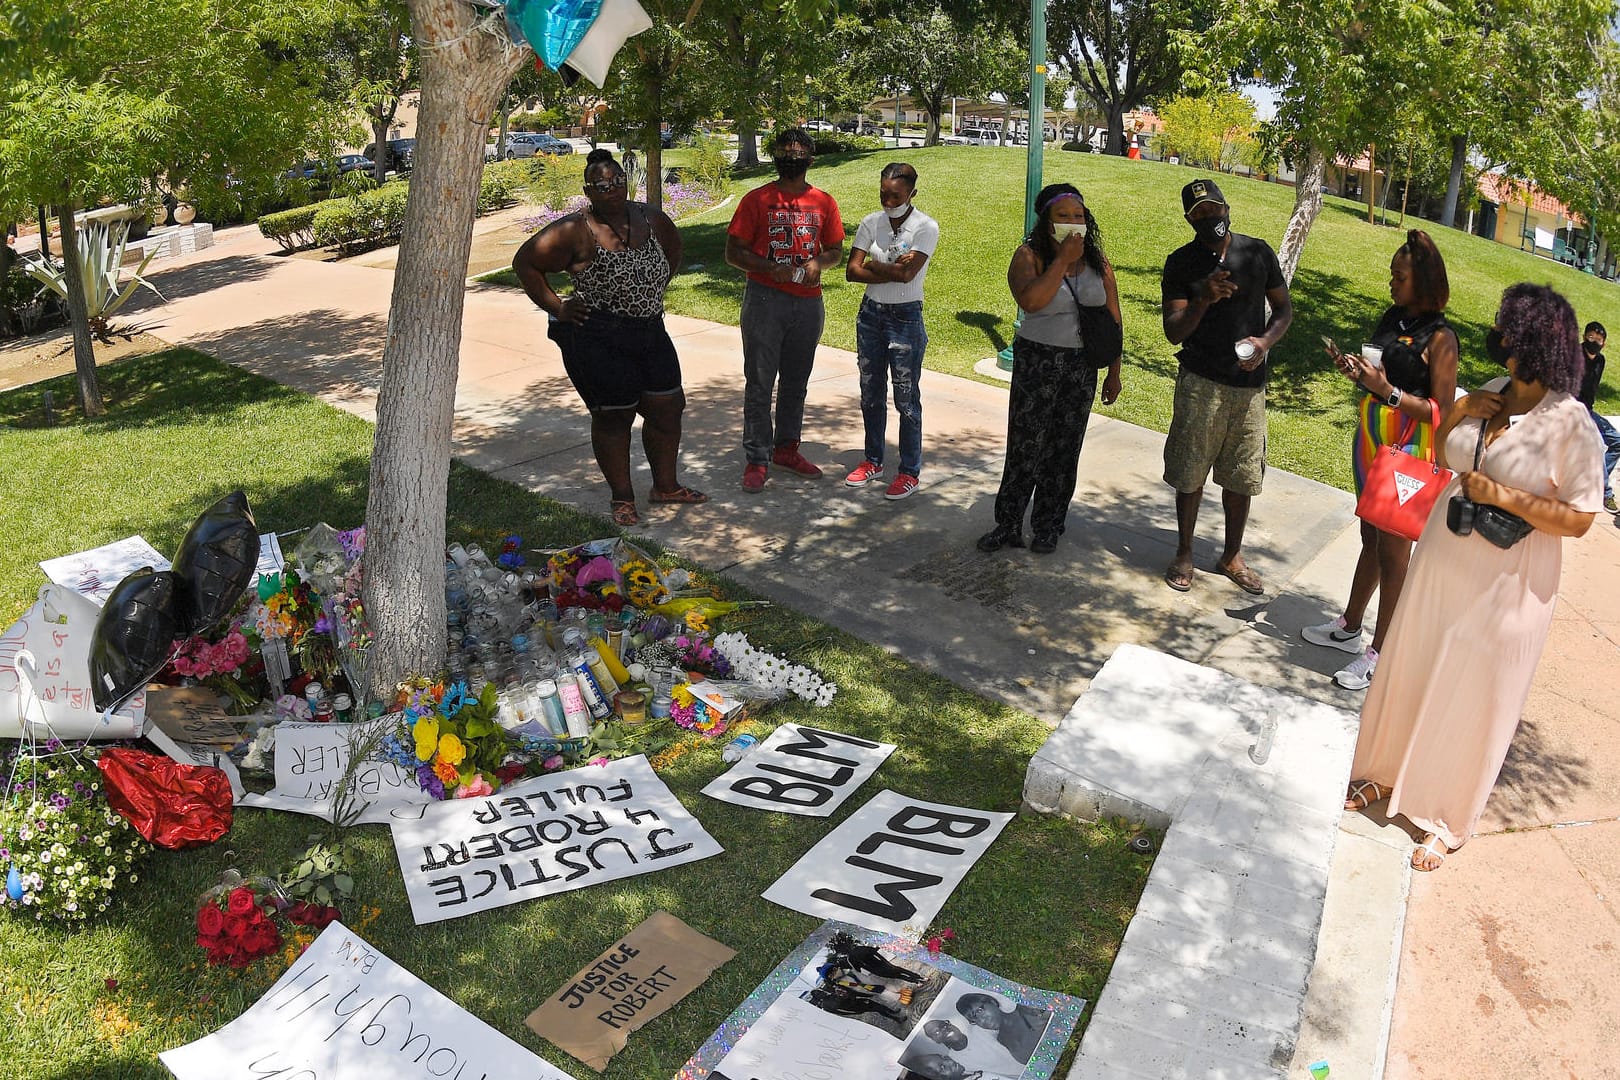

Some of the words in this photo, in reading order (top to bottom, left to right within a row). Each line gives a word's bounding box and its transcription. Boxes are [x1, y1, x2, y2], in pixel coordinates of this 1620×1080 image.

[1396, 473, 1420, 490] GUESS
[729, 727, 880, 808] BLM
[472, 778, 634, 825] FULLER
[623, 807, 660, 826] 4
[420, 810, 614, 872] ROBERT
[426, 827, 694, 908] JUSTICE
[809, 805, 992, 923] BLM
[335, 936, 381, 975] BLM
[558, 942, 641, 1009] JUSTICE
[598, 971, 639, 1001] FOR
[597, 964, 678, 1030] ROBERT
